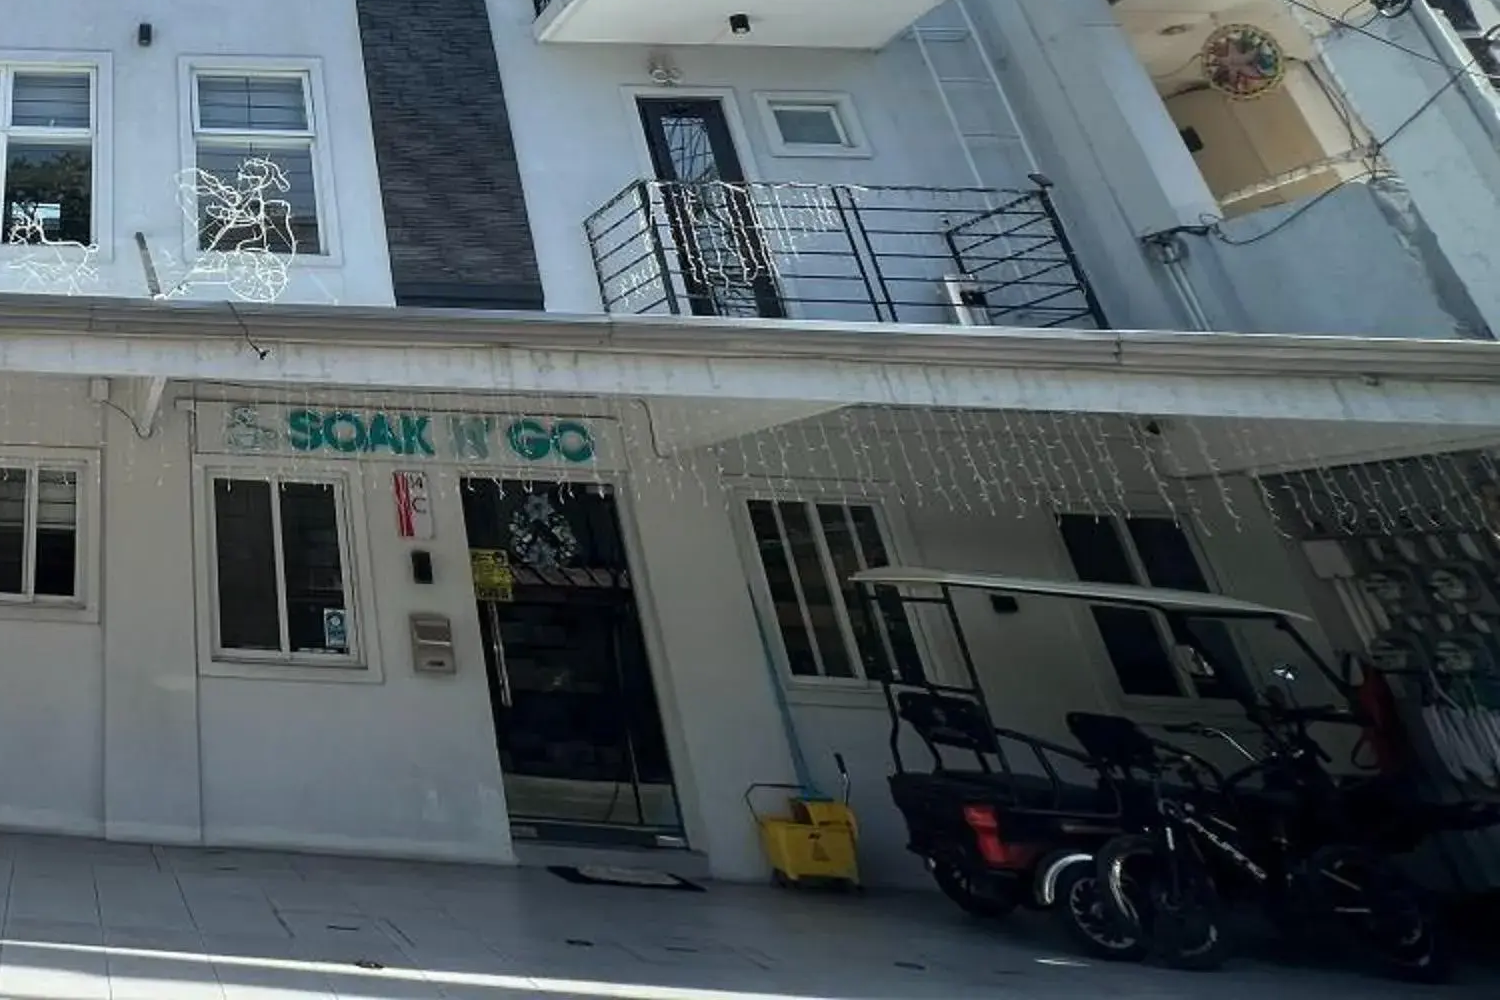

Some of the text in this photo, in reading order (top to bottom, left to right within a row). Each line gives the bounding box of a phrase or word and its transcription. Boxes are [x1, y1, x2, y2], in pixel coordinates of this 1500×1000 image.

[288, 408, 435, 456] SOAK
[507, 419, 595, 462] GO
[412, 497, 427, 514] C
